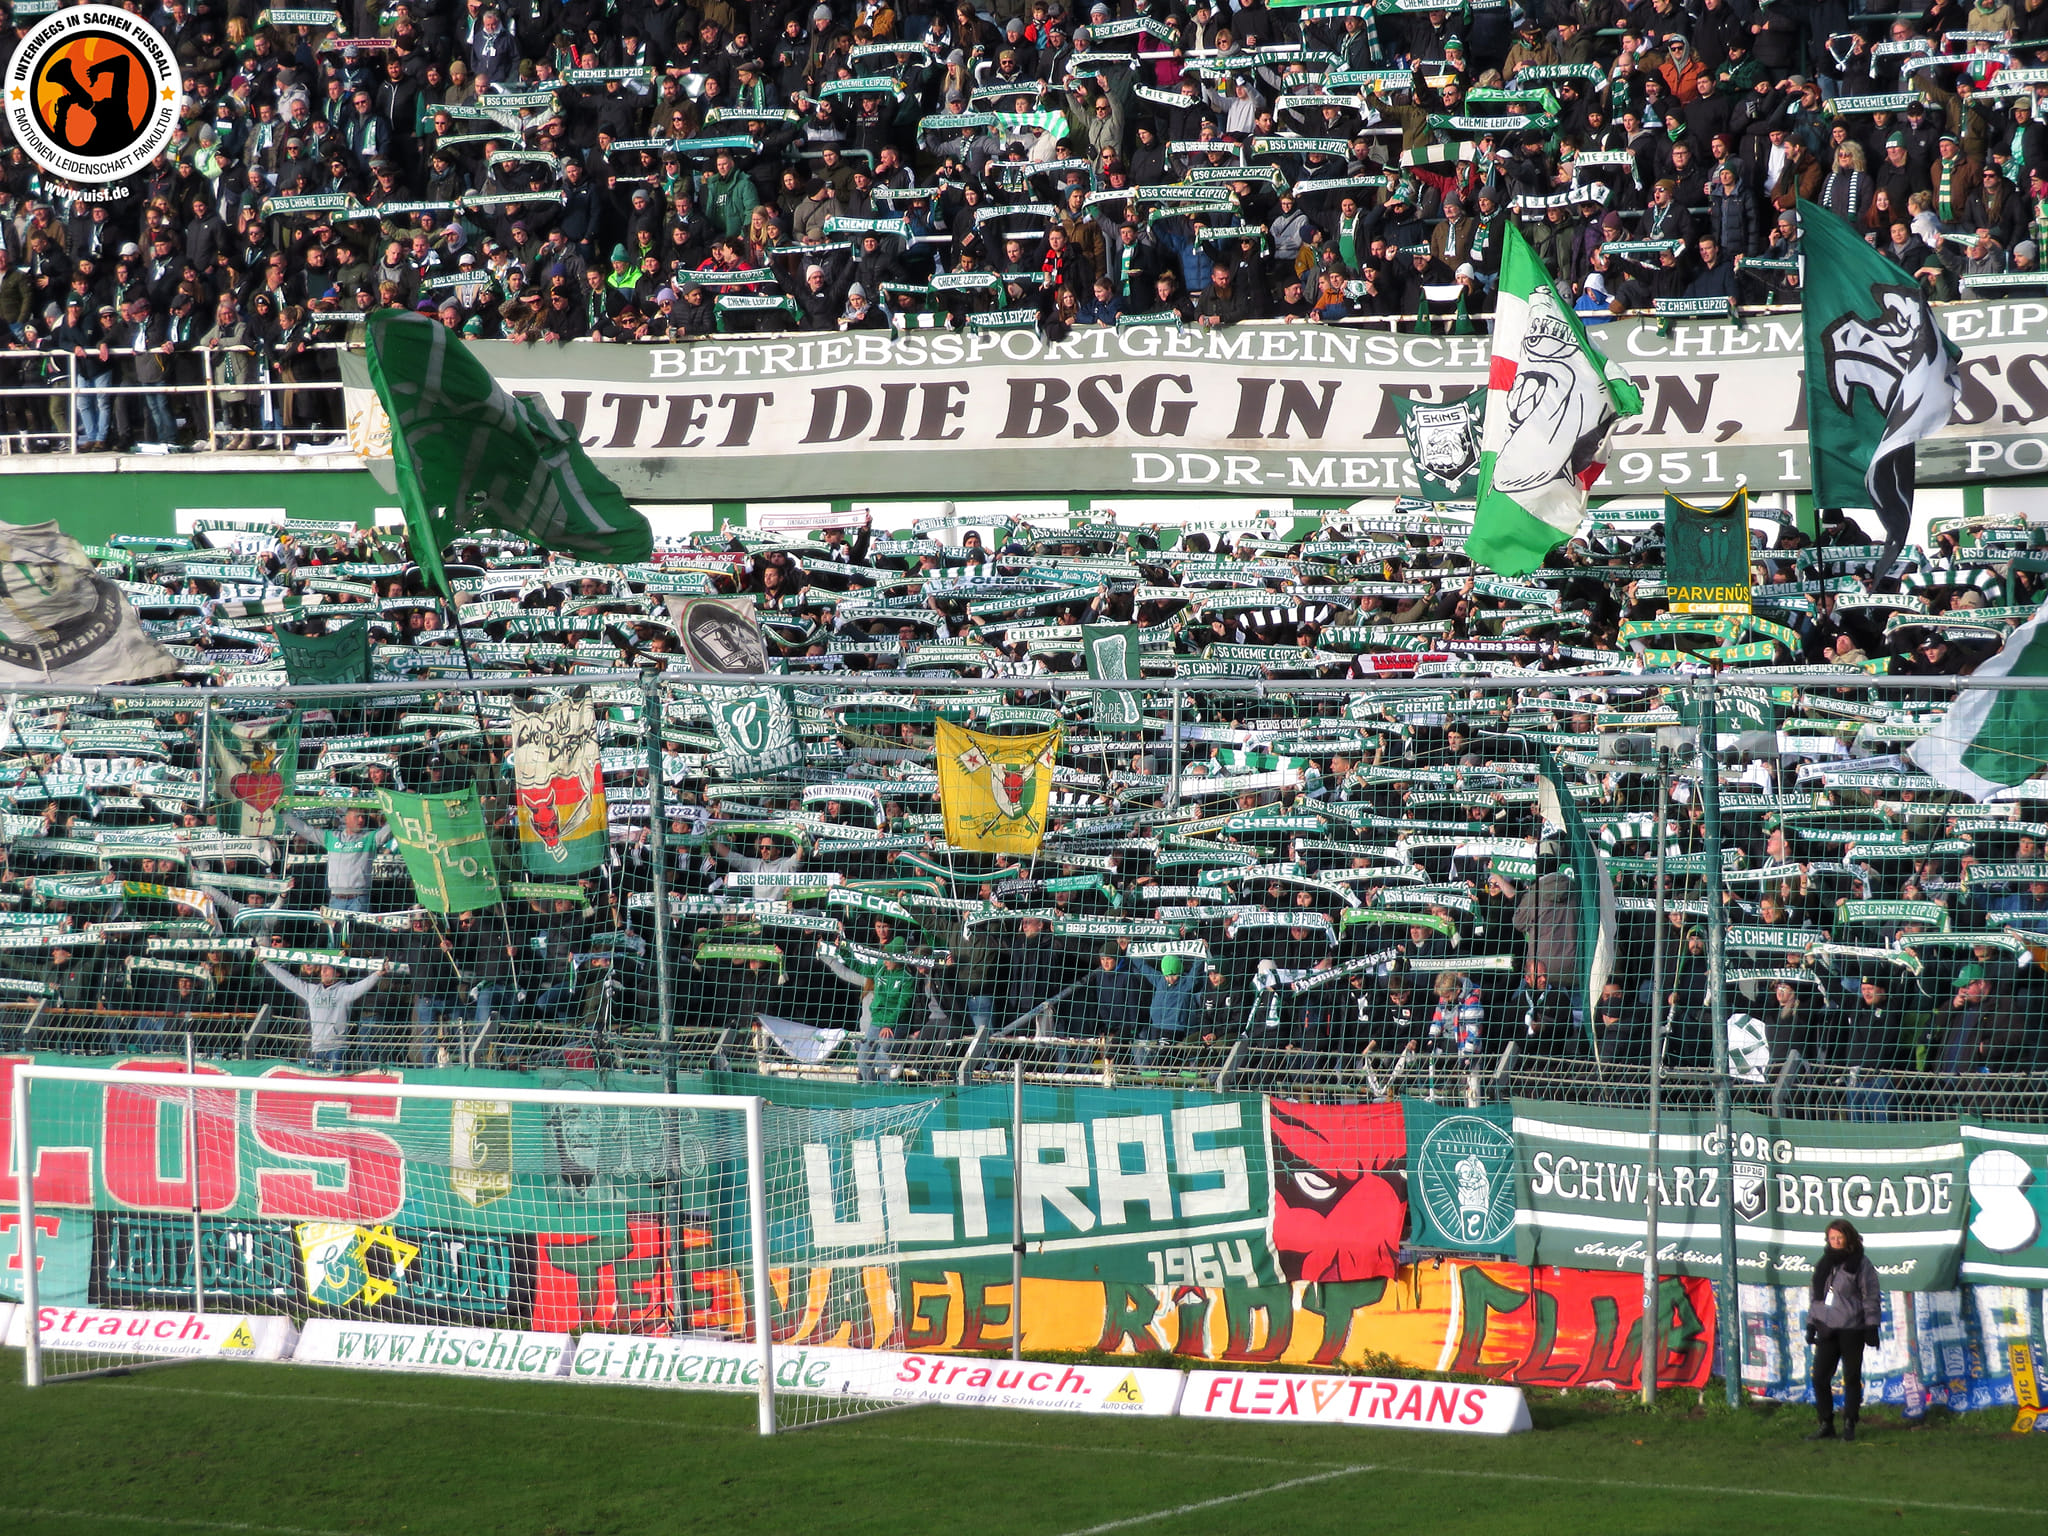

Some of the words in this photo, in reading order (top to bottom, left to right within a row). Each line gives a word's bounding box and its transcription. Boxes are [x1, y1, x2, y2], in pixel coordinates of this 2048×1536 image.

[272, 11, 285, 20] BSG
[286, 12, 310, 21] CHEMIE
[1095, 26, 1110, 35] BSG
[1112, 22, 1138, 33] CHEMIE
[1139, 19, 1169, 35] LEIPZIG
[572, 69, 606, 79] CHEMIE
[608, 68, 644, 78] LEIPZIG
[486, 96, 500, 106] BSG
[502, 96, 526, 105] CHEMIE
[1837, 100, 1852, 110] BSG
[1854, 98, 1885, 108] CHEMIE
[1887, 94, 1918, 105] LEIPZIG
[1458, 118, 1488, 127] CHEMIE
[1491, 118, 1520, 127] LEIPZIG
[1270, 141, 1288, 150] BSG
[1290, 141, 1318, 150] CHEMIE
[1320, 142, 1346, 153] LEIPZIG
[1193, 171, 1209, 180] BSG
[1211, 170, 1241, 179] CHEMIE
[1243, 169, 1272, 177] LEIPZIG
[1140, 188, 1157, 198] BSG
[1160, 188, 1192, 198] CHEMIE
[1195, 189, 1228, 200] LEIPZIG
[274, 201, 290, 210] BSG
[291, 199, 316, 209] CHEMIE
[317, 196, 344, 206] LEIPZIG
[838, 219, 874, 231] CHEMIE
[877, 219, 901, 230] FANS
[1668, 300, 1697, 310] CHEMIE
[1699, 299, 1728, 310] LEIPZIG
[649, 326, 1493, 378] BETRIEBSSPORTGEMEINSCH
[1626, 321, 1804, 358] CHEM
[530, 391, 773, 449] LTET
[800, 381, 969, 444] DIE
[998, 374, 1198, 440] BSG
[1227, 378, 1341, 440] IN
[1422, 411, 1462, 424] SKINS
[1132, 452, 1420, 488] DDR-MEIS
[1593, 511, 1621, 520] WIR
[1626, 511, 1659, 520] SIND
[1962, 548, 1982, 558] BSG
[1986, 548, 2025, 558] CHEMIE
[186, 565, 222, 577] CHEMIE
[224, 565, 252, 576] FANS
[1667, 584, 1749, 602] PARVENÜS
[1752, 583, 1798, 596] CHEMIE
[131, 595, 169, 606] CHEMIE
[1212, 648, 1229, 657] BSG
[1232, 647, 1266, 658] CHEMIE
[1450, 642, 1502, 651] RADLERS
[1505, 642, 1536, 651] BSGE
[1192, 662, 1228, 674] CHEMIE
[1396, 701, 1443, 713] CHEMIE
[1448, 699, 1496, 710] LEIPZIG
[991, 711, 1004, 721] BSG
[1005, 710, 1031, 720] CHEMIE
[1032, 711, 1056, 722] LEIPZIG
[1406, 794, 1448, 807] CHEMIE
[1450, 793, 1495, 806] LEIPZIG
[1720, 793, 1736, 806] BSG
[1739, 793, 1773, 806] CHEMIE
[1774, 792, 1811, 805] LEIPZIG
[1228, 817, 1318, 829] CHEMIE
[1971, 865, 1994, 879] BSG
[1997, 865, 2035, 879] CHEMIE
[737, 874, 755, 885] BSG
[757, 874, 791, 885] CHEMIE
[794, 874, 828, 885] LEIPZIG
[1385, 891, 1401, 902] BSG
[1404, 892, 1436, 904] CHEMIE
[1438, 895, 1471, 910] LEIPZIG
[671, 901, 788, 915] DIABLOS
[1850, 904, 1867, 914] BSG
[1869, 904, 1903, 915] CHEMIE
[1906, 904, 1940, 917] LEIPZIG
[1746, 929, 1784, 945] CHEMIE
[149, 938, 253, 951] DIABLOS
[261, 948, 385, 970] DIABLOS
[804, 1101, 1250, 1248] ULTRAS
[1733, 1164, 1765, 1177] LEIPZIG
[1530, 1151, 1721, 1207] SCHWARZ
[1775, 1173, 1953, 1217] BRIGADE
[1574, 1241, 1722, 1268] Antifashistisch
[1736, 1254, 1768, 1269] und
[1147, 1240, 1259, 1288] 1964
[37, 1307, 211, 1341] Strauch.
[1100, 1280, 1388, 1364] RIOT
[1459, 1264, 1708, 1385] CLUB
[87, 1340, 127, 1351] GmbH
[575, 1340, 831, 1388] ei-thiemede
[897, 1356, 1093, 1395] Strauch.
[1119, 1380, 1138, 1400] AC
[893, 1387, 912, 1399] Die
[917, 1389, 951, 1401] Auto
[956, 1391, 997, 1404] GmbH
[1002, 1394, 1083, 1409] Schkeuditz
[1205, 1377, 1304, 1416] FLEX
[1340, 1380, 1487, 1425] TRANS
[1101, 1401, 1121, 1410] AUTO
[1123, 1402, 1144, 1411] CHECK
